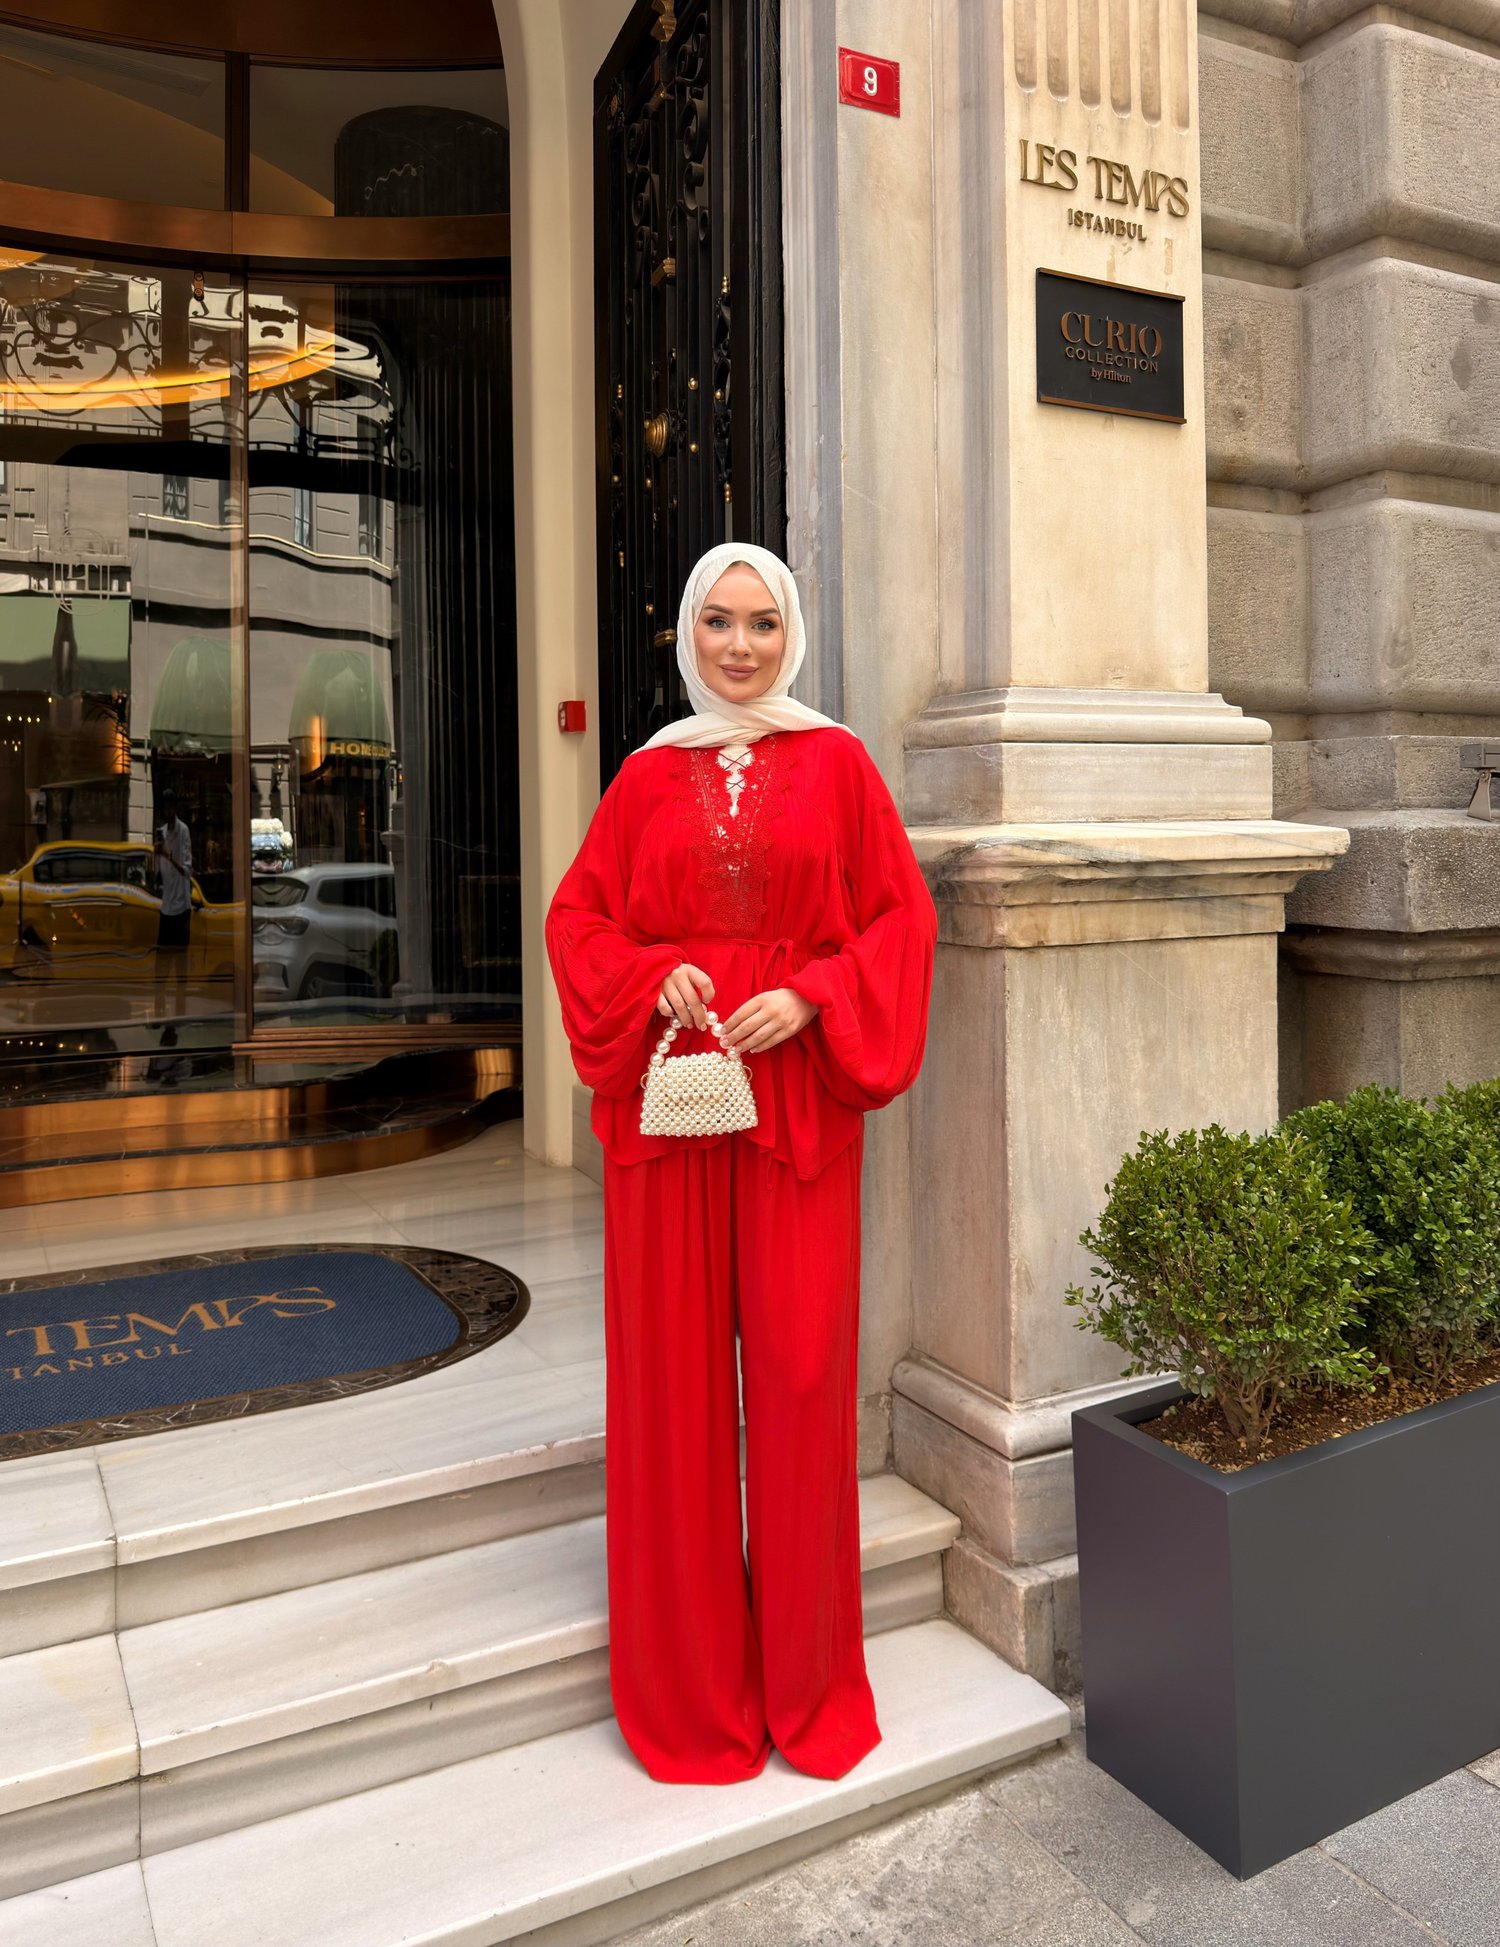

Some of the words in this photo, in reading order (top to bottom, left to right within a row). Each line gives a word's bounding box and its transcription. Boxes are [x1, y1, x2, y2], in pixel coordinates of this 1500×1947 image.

[864, 66, 878, 97] 9
[1019, 138, 1079, 192] LES
[1086, 155, 1190, 218] TEMPS
[1067, 207, 1148, 242] ISTANBUL
[1060, 311, 1163, 359] CURIO
[1064, 345, 1159, 374] COLLECTION
[1091, 367, 1102, 381] by
[1103, 369, 1132, 384] Hilton
[5, 1286, 338, 1356] TEMPS
